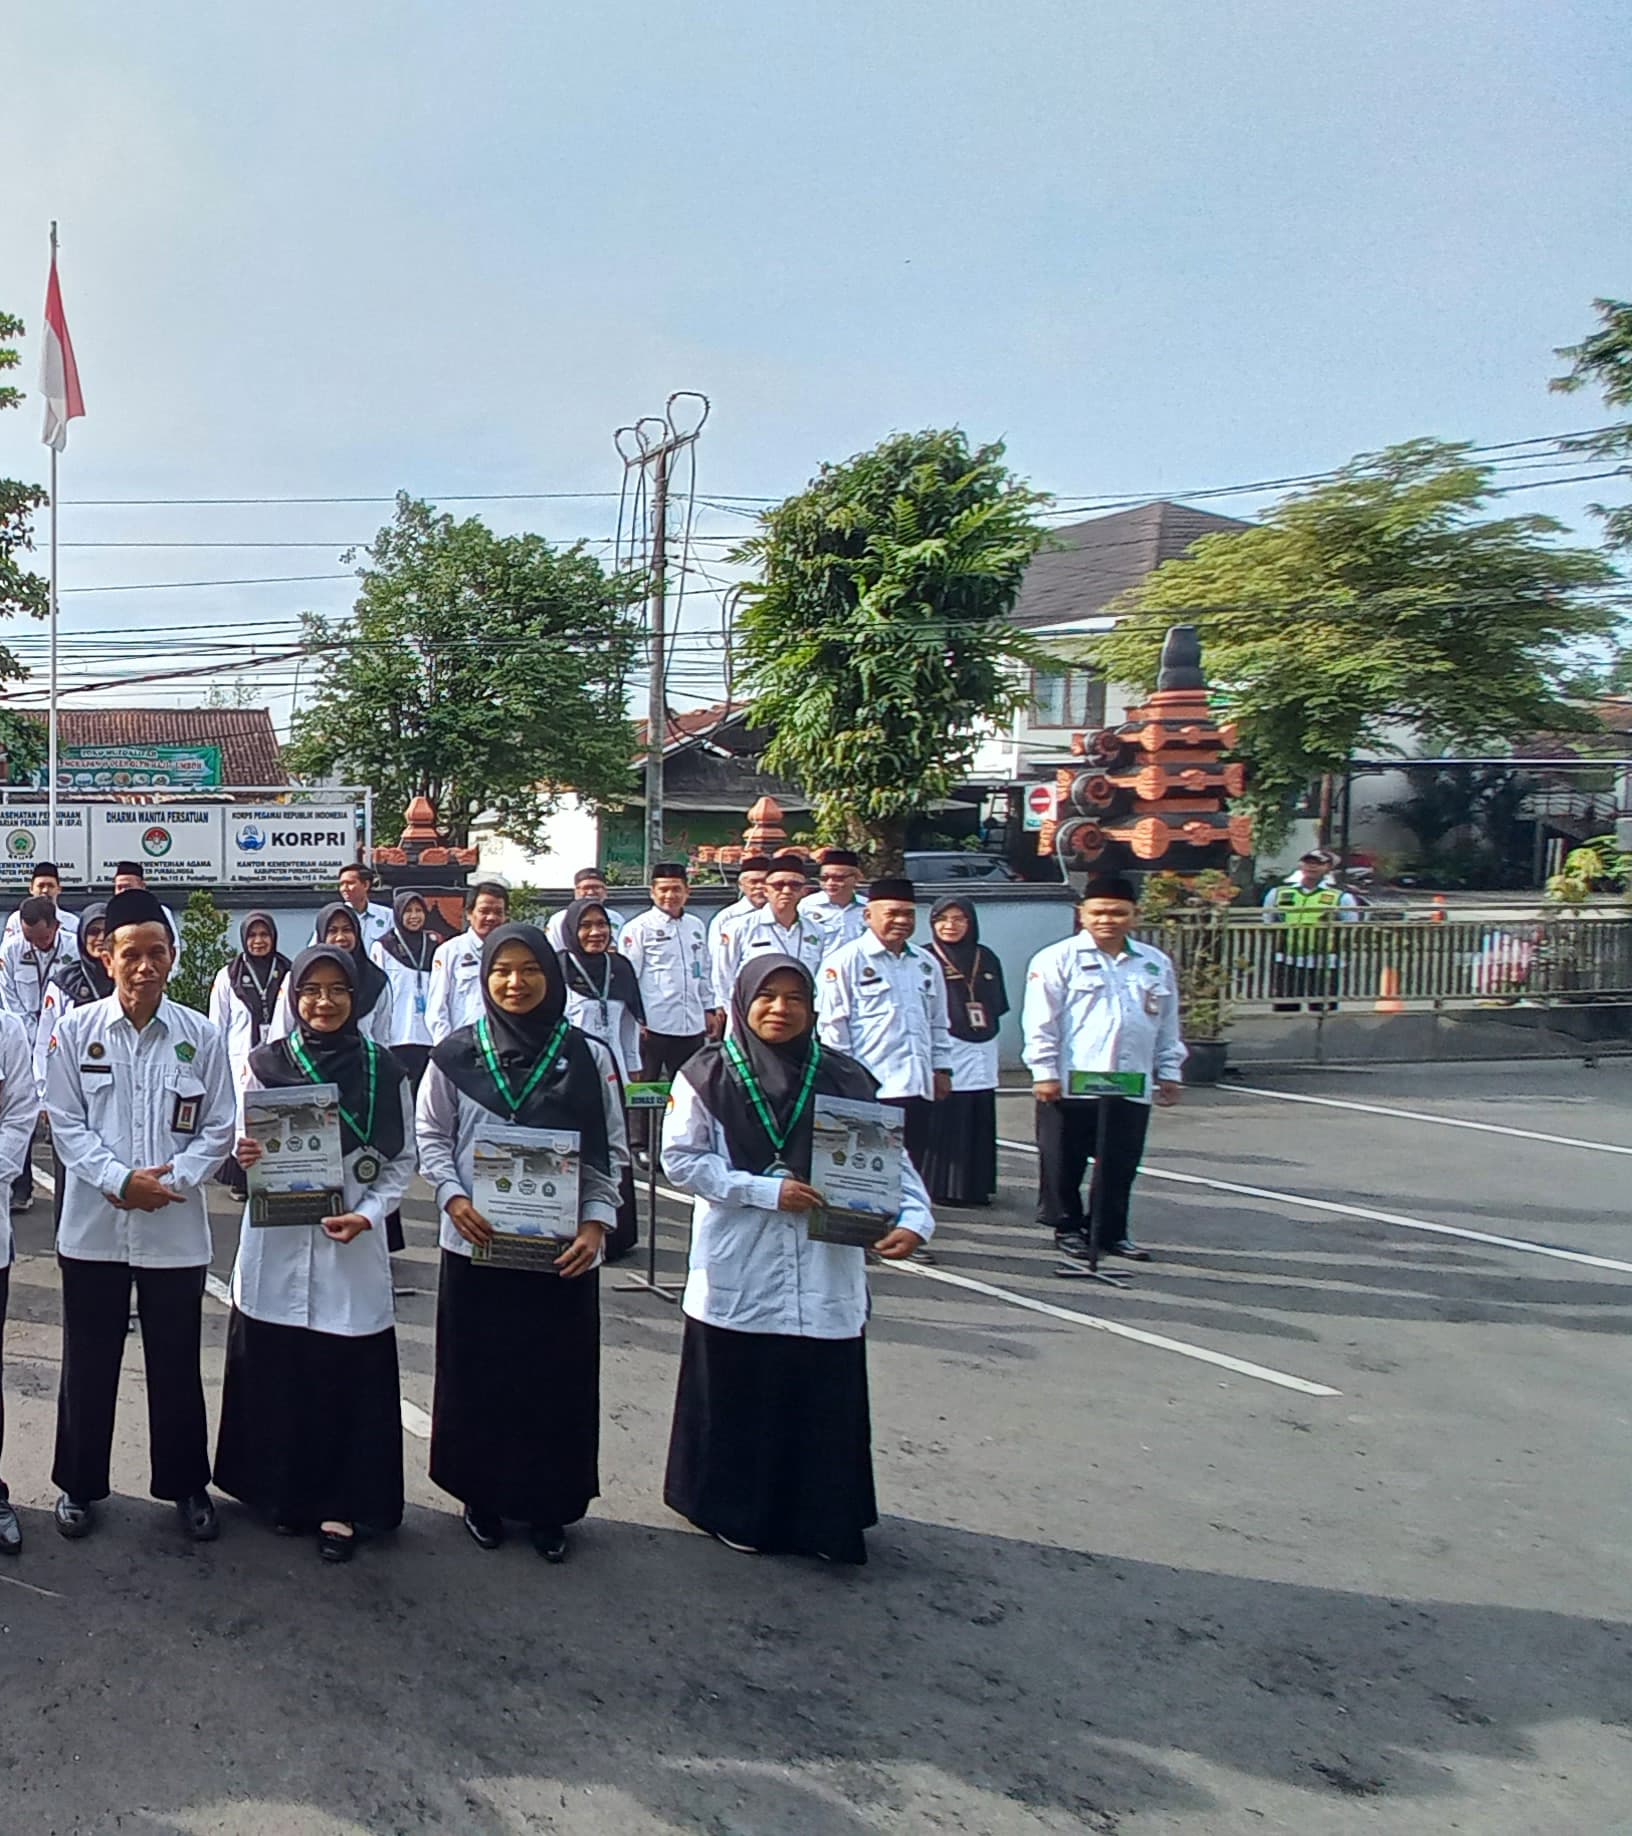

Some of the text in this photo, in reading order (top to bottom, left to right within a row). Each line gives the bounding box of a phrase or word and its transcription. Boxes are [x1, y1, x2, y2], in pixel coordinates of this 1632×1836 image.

[106, 811, 209, 823] DHARMA WANITA PERSATUAN
[314, 811, 348, 819] INDONESIA
[271, 832, 346, 847] KORPRI
